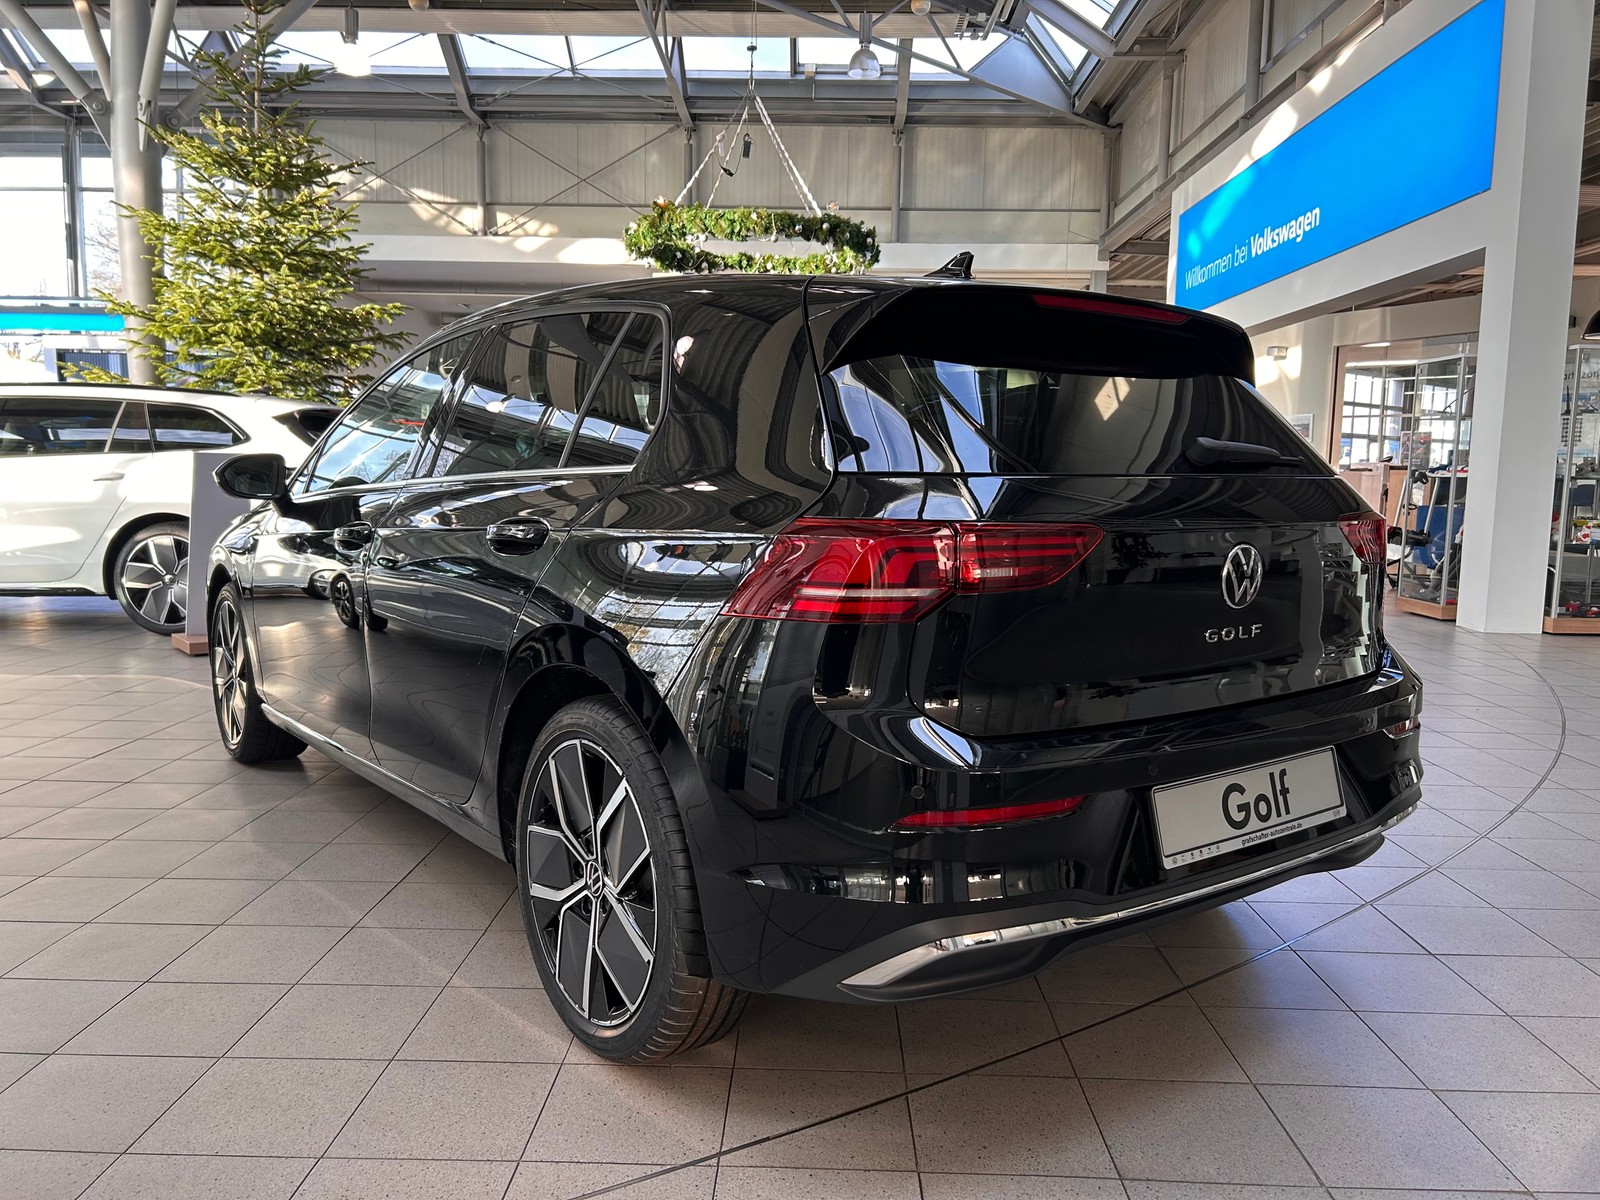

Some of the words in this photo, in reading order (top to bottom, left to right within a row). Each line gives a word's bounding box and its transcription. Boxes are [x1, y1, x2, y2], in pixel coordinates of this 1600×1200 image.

[1185, 253, 1233, 290] Willkommen
[1234, 240, 1249, 267] bei
[1250, 206, 1320, 258] Volkswagen
[1222, 544, 1262, 609] VW
[1204, 623, 1263, 643] GOLF
[1221, 768, 1291, 831] Golf
[1241, 822, 1303, 847] grafschafter-autozentrale.de
